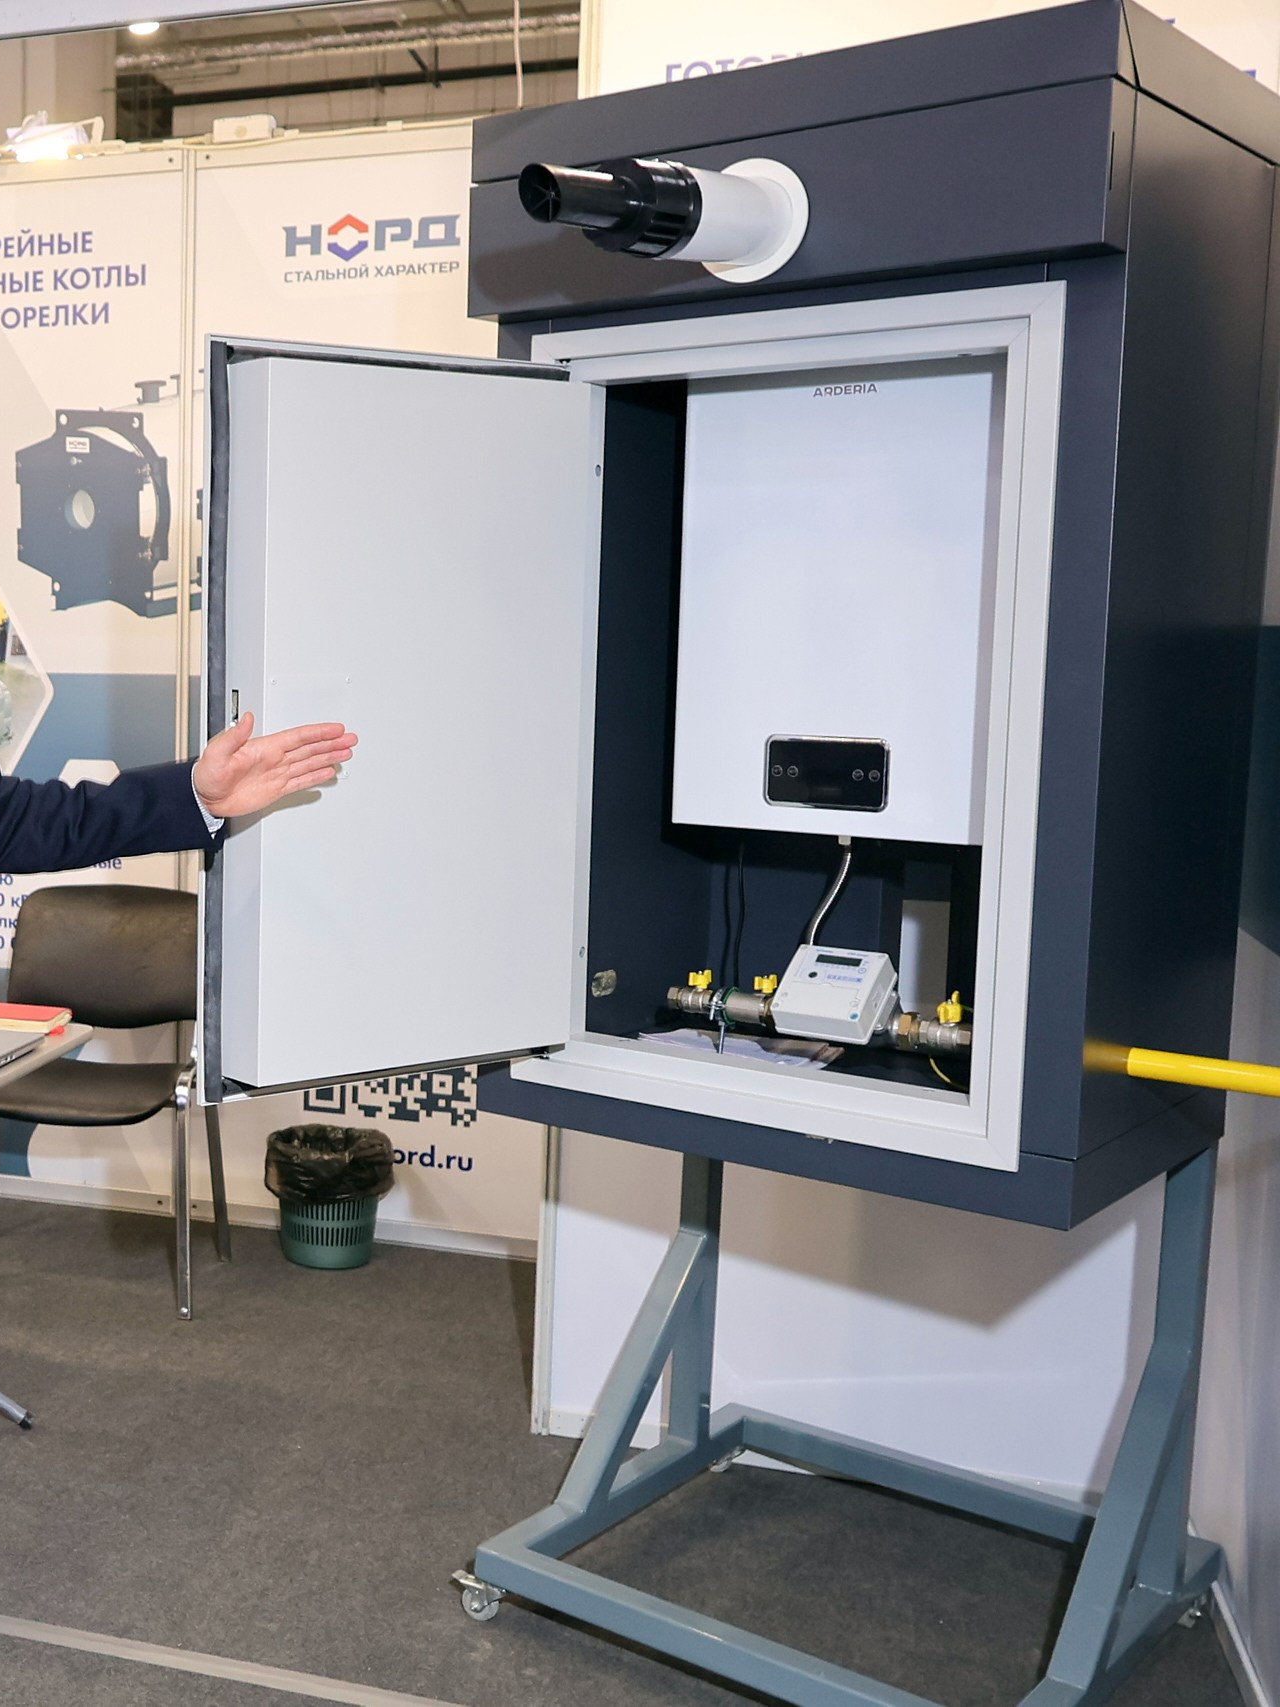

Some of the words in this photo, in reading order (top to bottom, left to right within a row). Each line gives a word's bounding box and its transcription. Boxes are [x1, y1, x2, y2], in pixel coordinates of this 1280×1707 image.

[282, 213, 461, 262] НОРД
[53, 264, 147, 291] КОТЛЫ
[284, 264, 369, 283] СТАЛЬНОЙ
[374, 261, 460, 277] ХАРАКТЕР
[813, 383, 878, 397] ARDERIA
[392, 1144, 473, 1172] ord.ru
